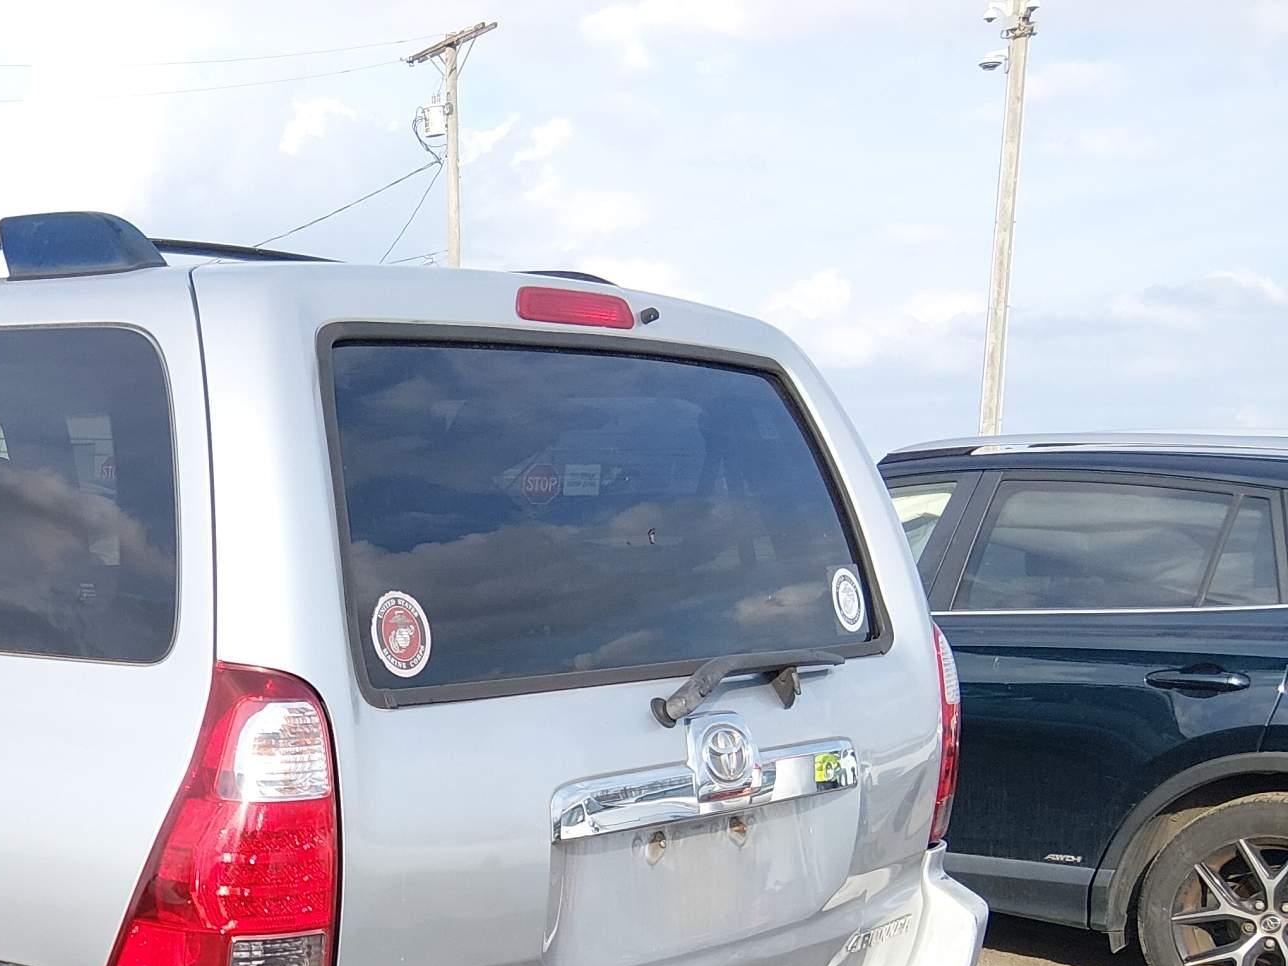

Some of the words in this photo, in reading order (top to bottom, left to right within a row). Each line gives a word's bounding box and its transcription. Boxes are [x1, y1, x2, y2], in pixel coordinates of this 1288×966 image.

[525, 476, 558, 493] STOP
[377, 598, 396, 619] UNITED
[397, 598, 419, 618] STATES
[382, 647, 407, 669] MARINE
[409, 644, 425, 668] CORPS
